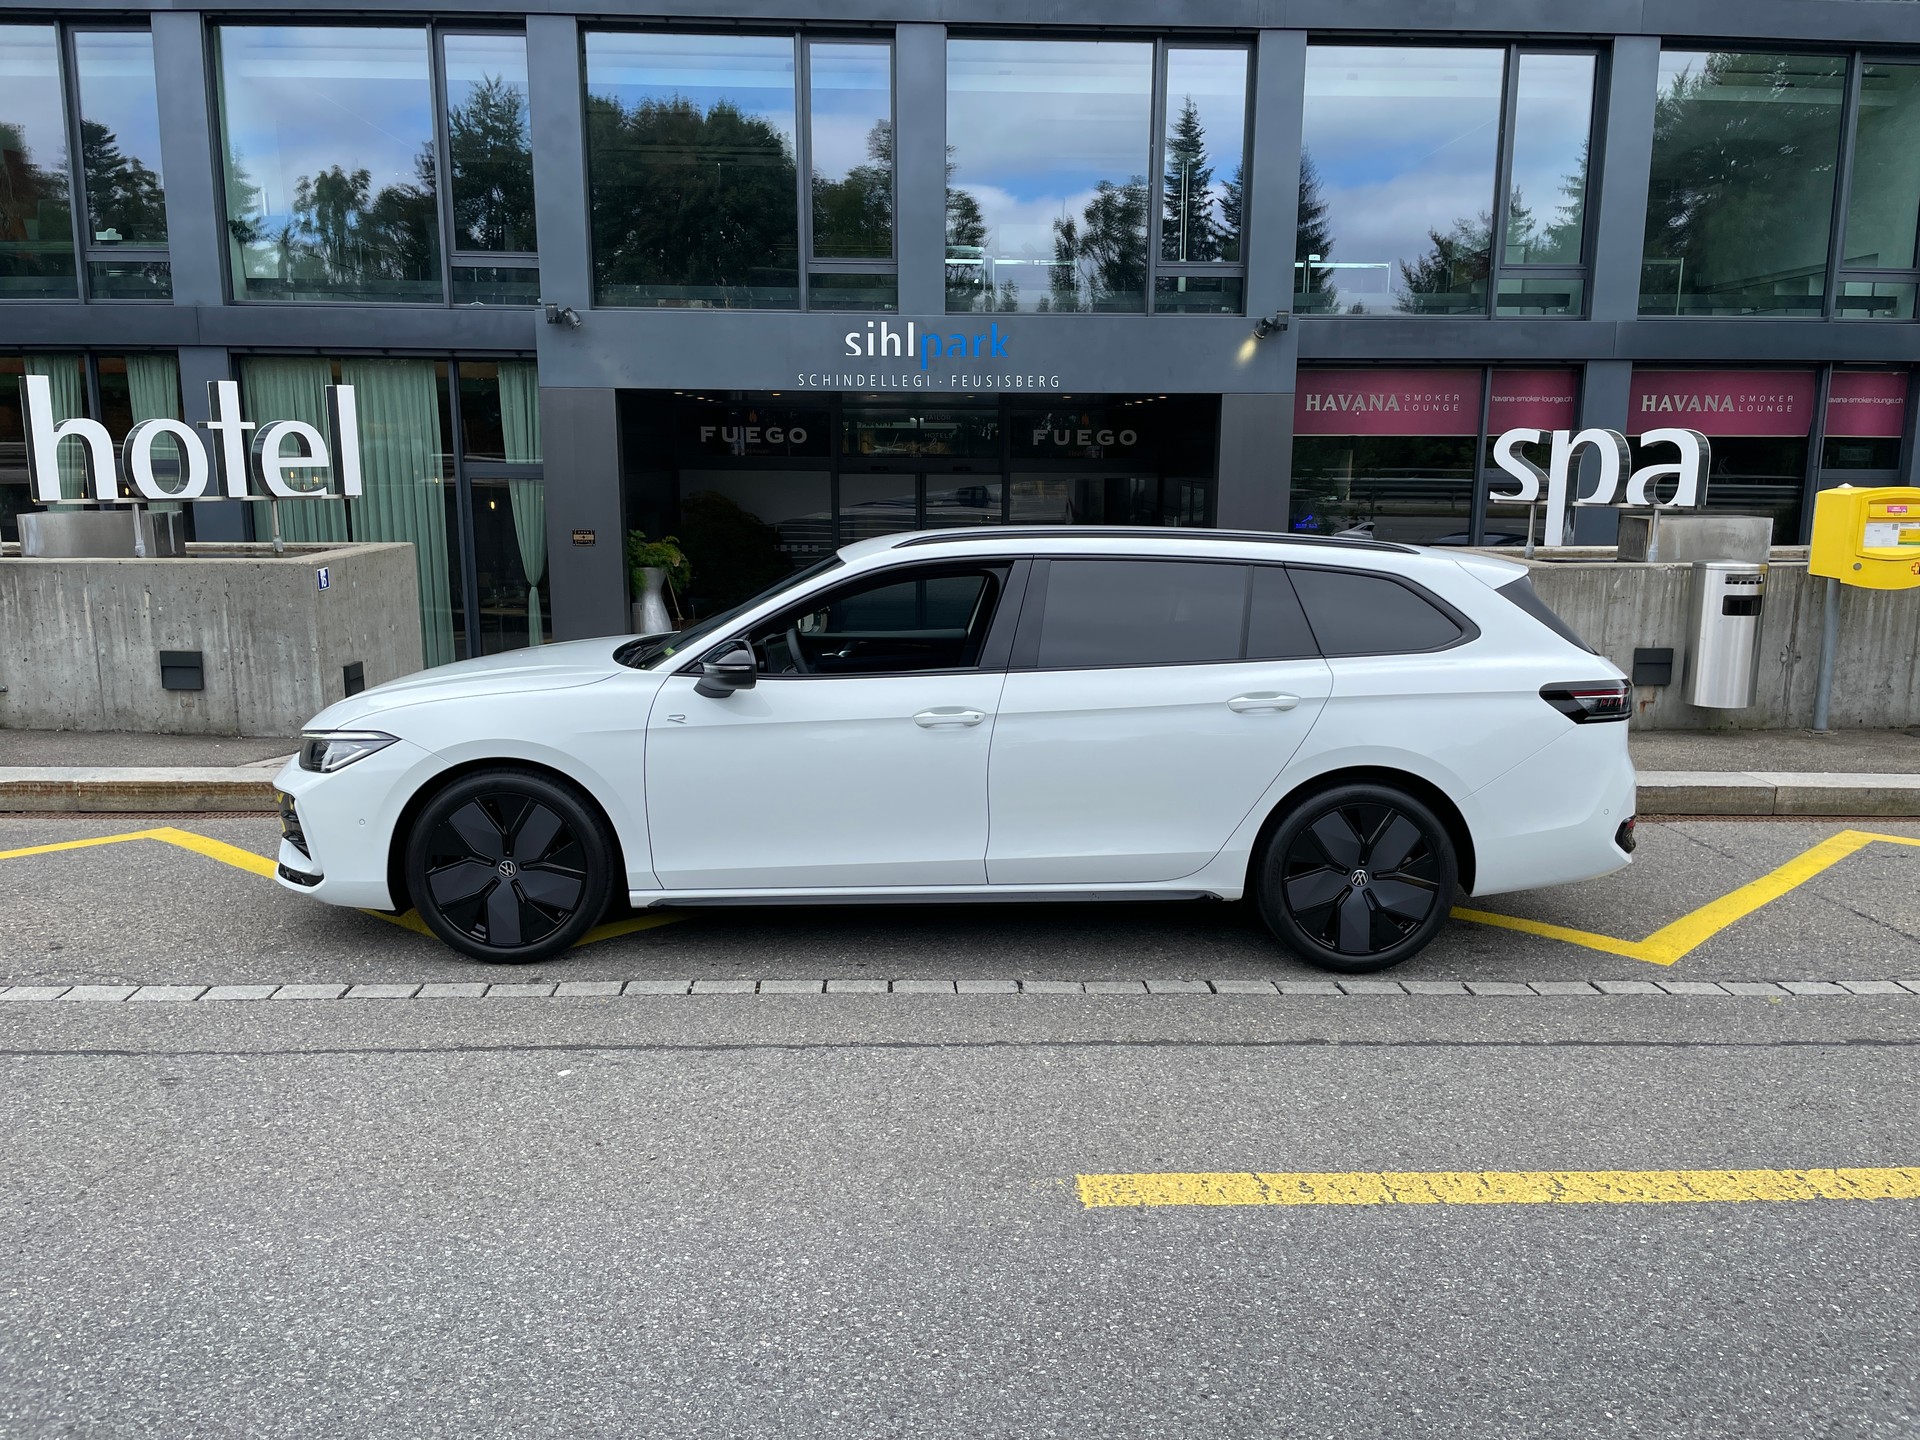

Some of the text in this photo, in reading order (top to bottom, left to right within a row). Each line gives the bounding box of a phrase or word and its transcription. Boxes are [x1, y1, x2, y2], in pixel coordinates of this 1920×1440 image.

[845, 320, 1010, 370] sihlpark
[798, 374, 1061, 389] SCHINDELLEGI FEUSISBERG
[1305, 394, 1460, 412] HAVANA SMOKER
[1404, 404, 1459, 412] LOUNGE
[1491, 395, 1573, 404] havana-smoker-lounge.ch
[1640, 394, 1794, 412] HAVANA SMOKER
[1828, 396, 1904, 406] avana-smoker-lounge.ch
[1738, 404, 1793, 413] LOUNGE
[19, 375, 363, 503] hotel
[700, 426, 808, 444] FUEGO
[1032, 429, 1138, 446] FUEGO
[1490, 428, 1711, 546] spa
